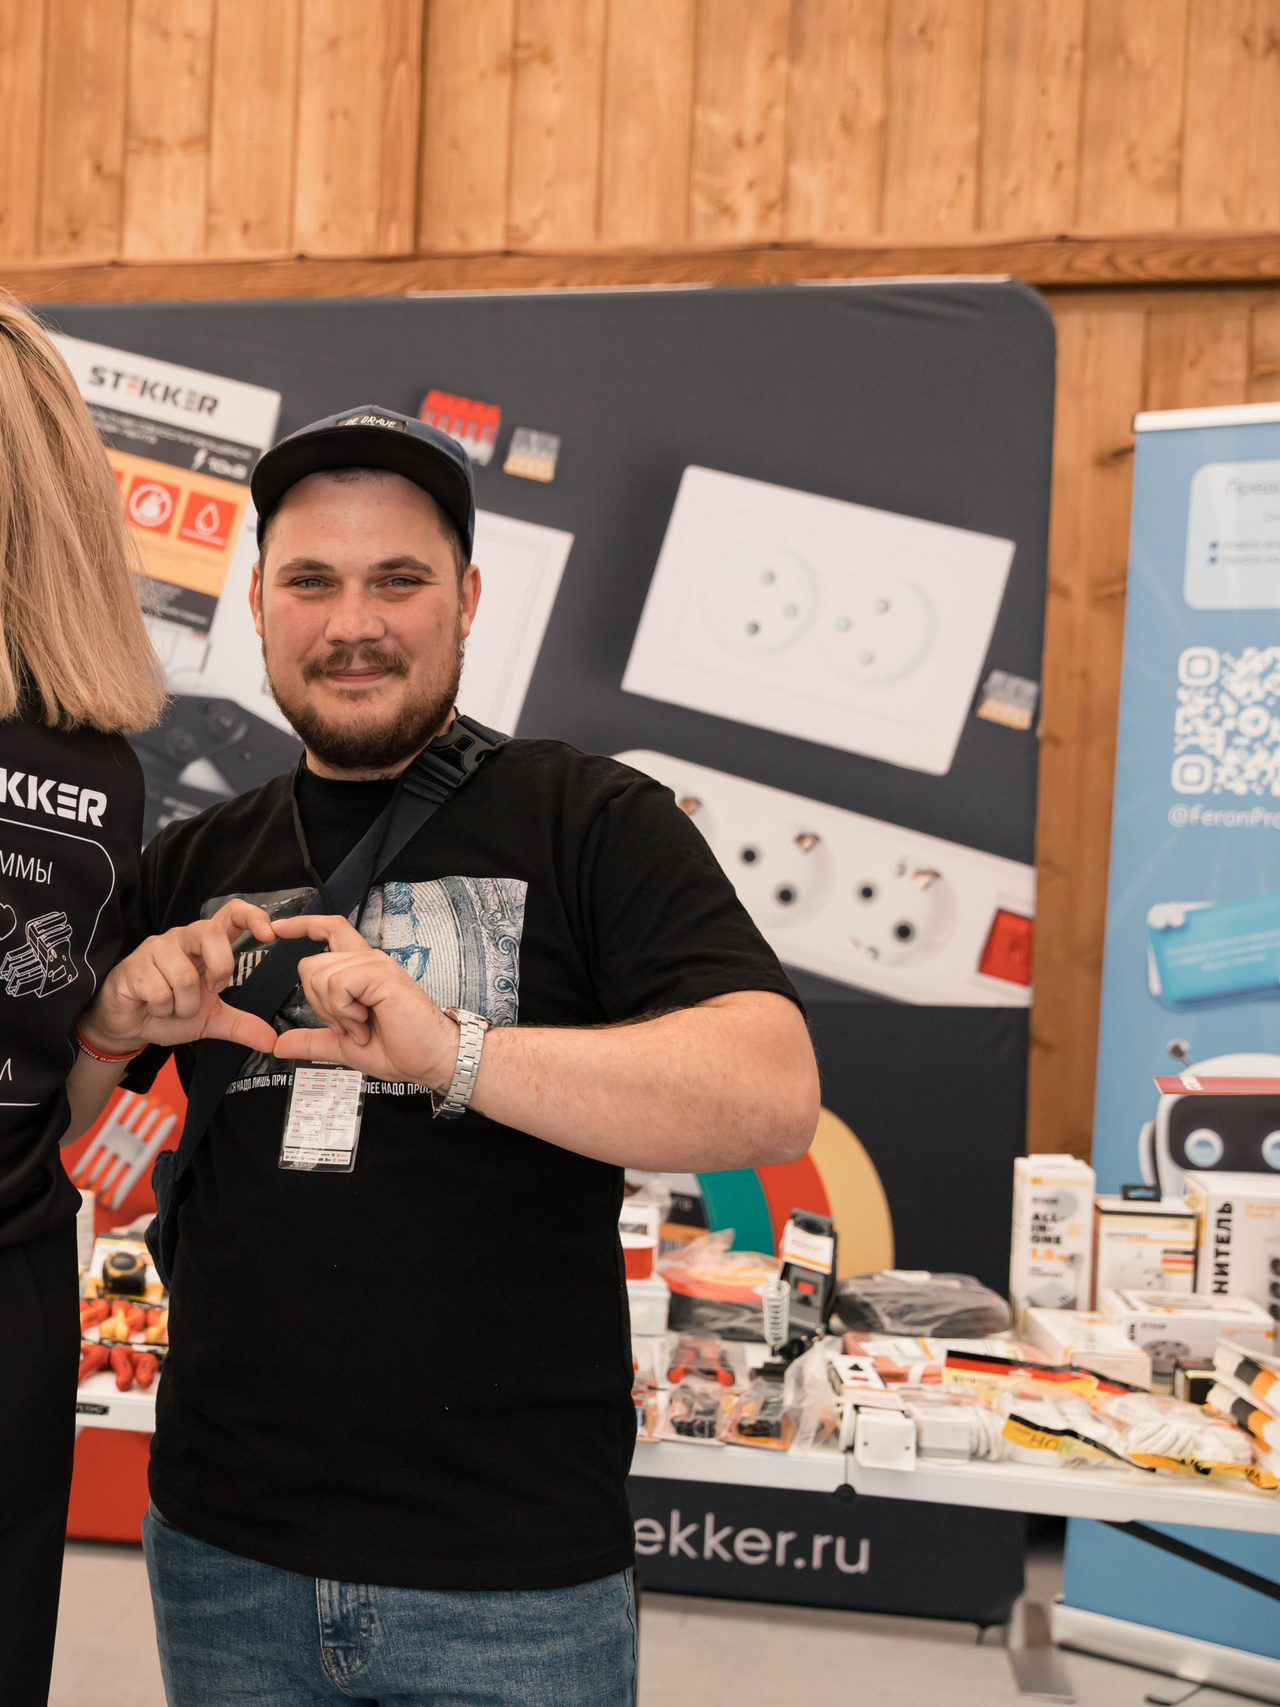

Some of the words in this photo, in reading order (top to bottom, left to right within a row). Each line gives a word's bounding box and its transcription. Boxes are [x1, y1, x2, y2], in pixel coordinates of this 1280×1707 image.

[87, 366, 219, 417] STEKKER
[360, 415, 397, 428] BRAVE
[252, 1075, 271, 1090] ЛИШЬ
[271, 1074, 288, 1087] ПРИ
[381, 1081, 406, 1097] НАДО
[1213, 1202, 1233, 1294] НИТЕЛЬ
[634, 1508, 871, 1575] ekker.ru
